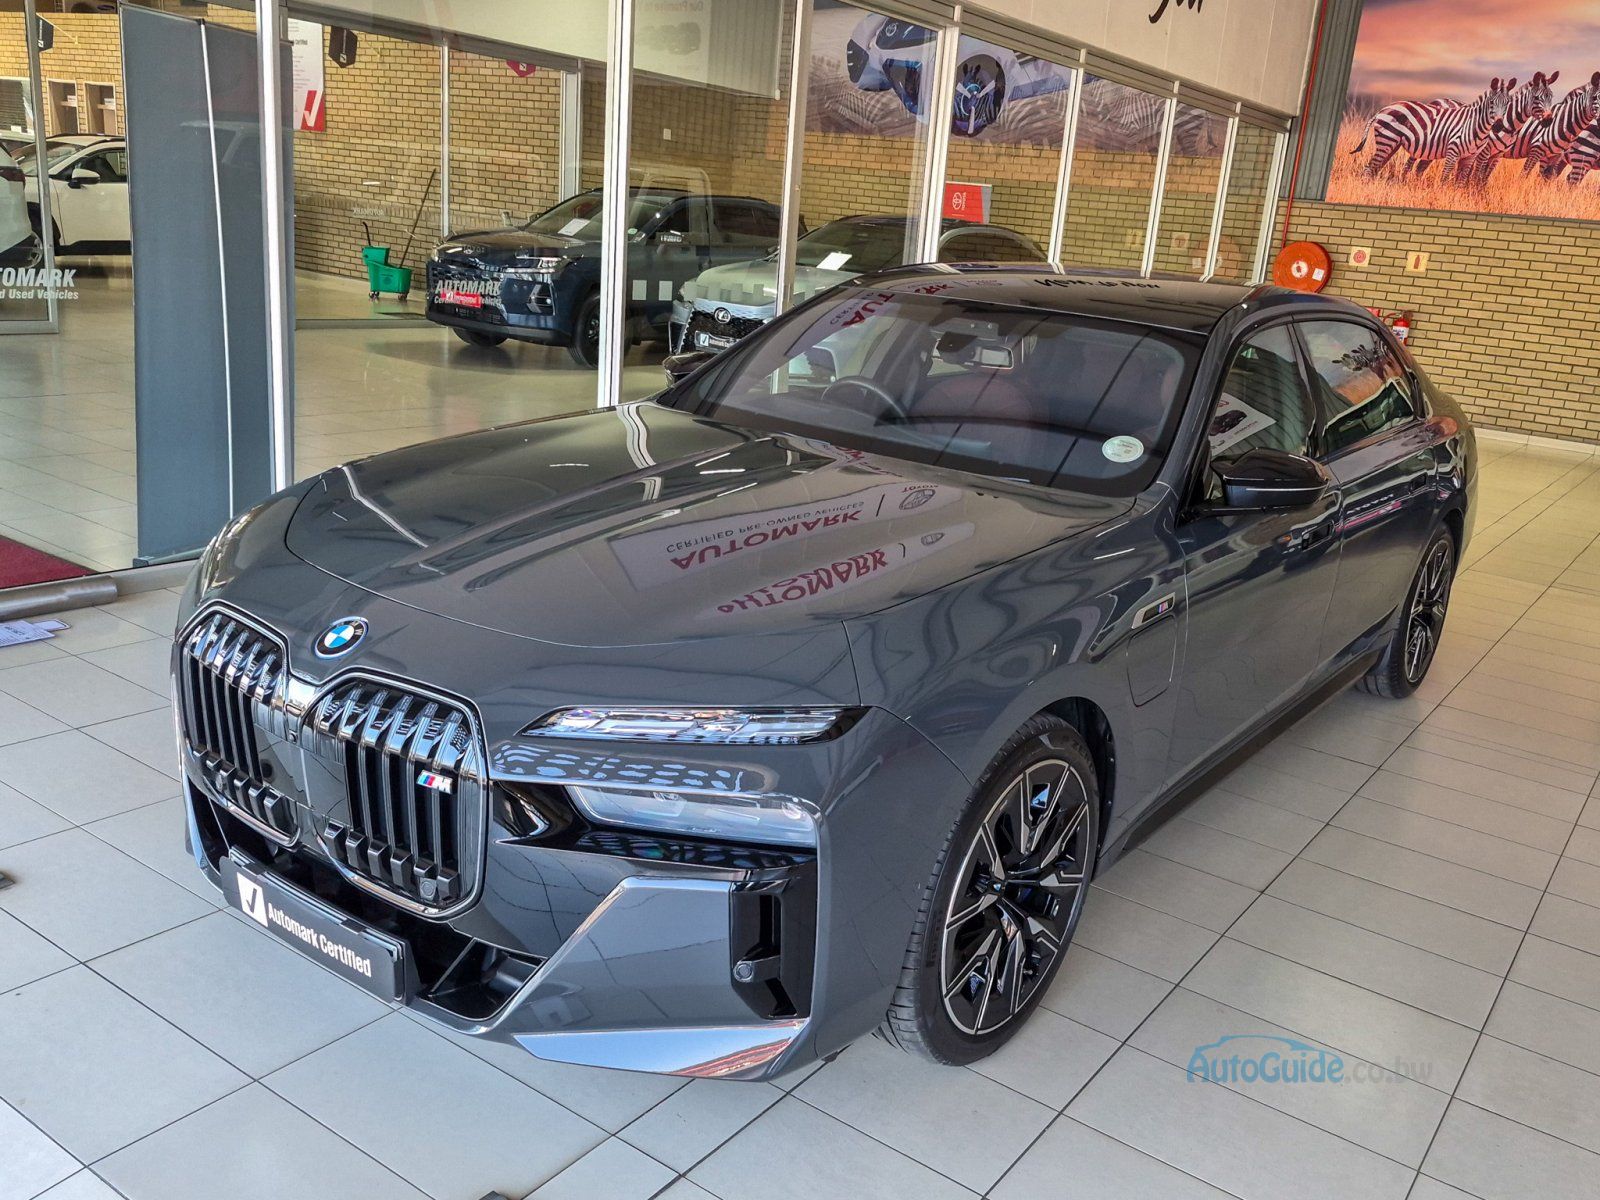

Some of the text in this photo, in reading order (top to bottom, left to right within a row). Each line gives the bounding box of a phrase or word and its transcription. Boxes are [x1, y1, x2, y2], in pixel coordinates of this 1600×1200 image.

[9, 288, 34, 299] Used
[37, 289, 79, 300] Vehicles
[435, 279, 501, 296] AUTOMARK
[267, 902, 372, 978] Automark Certified
